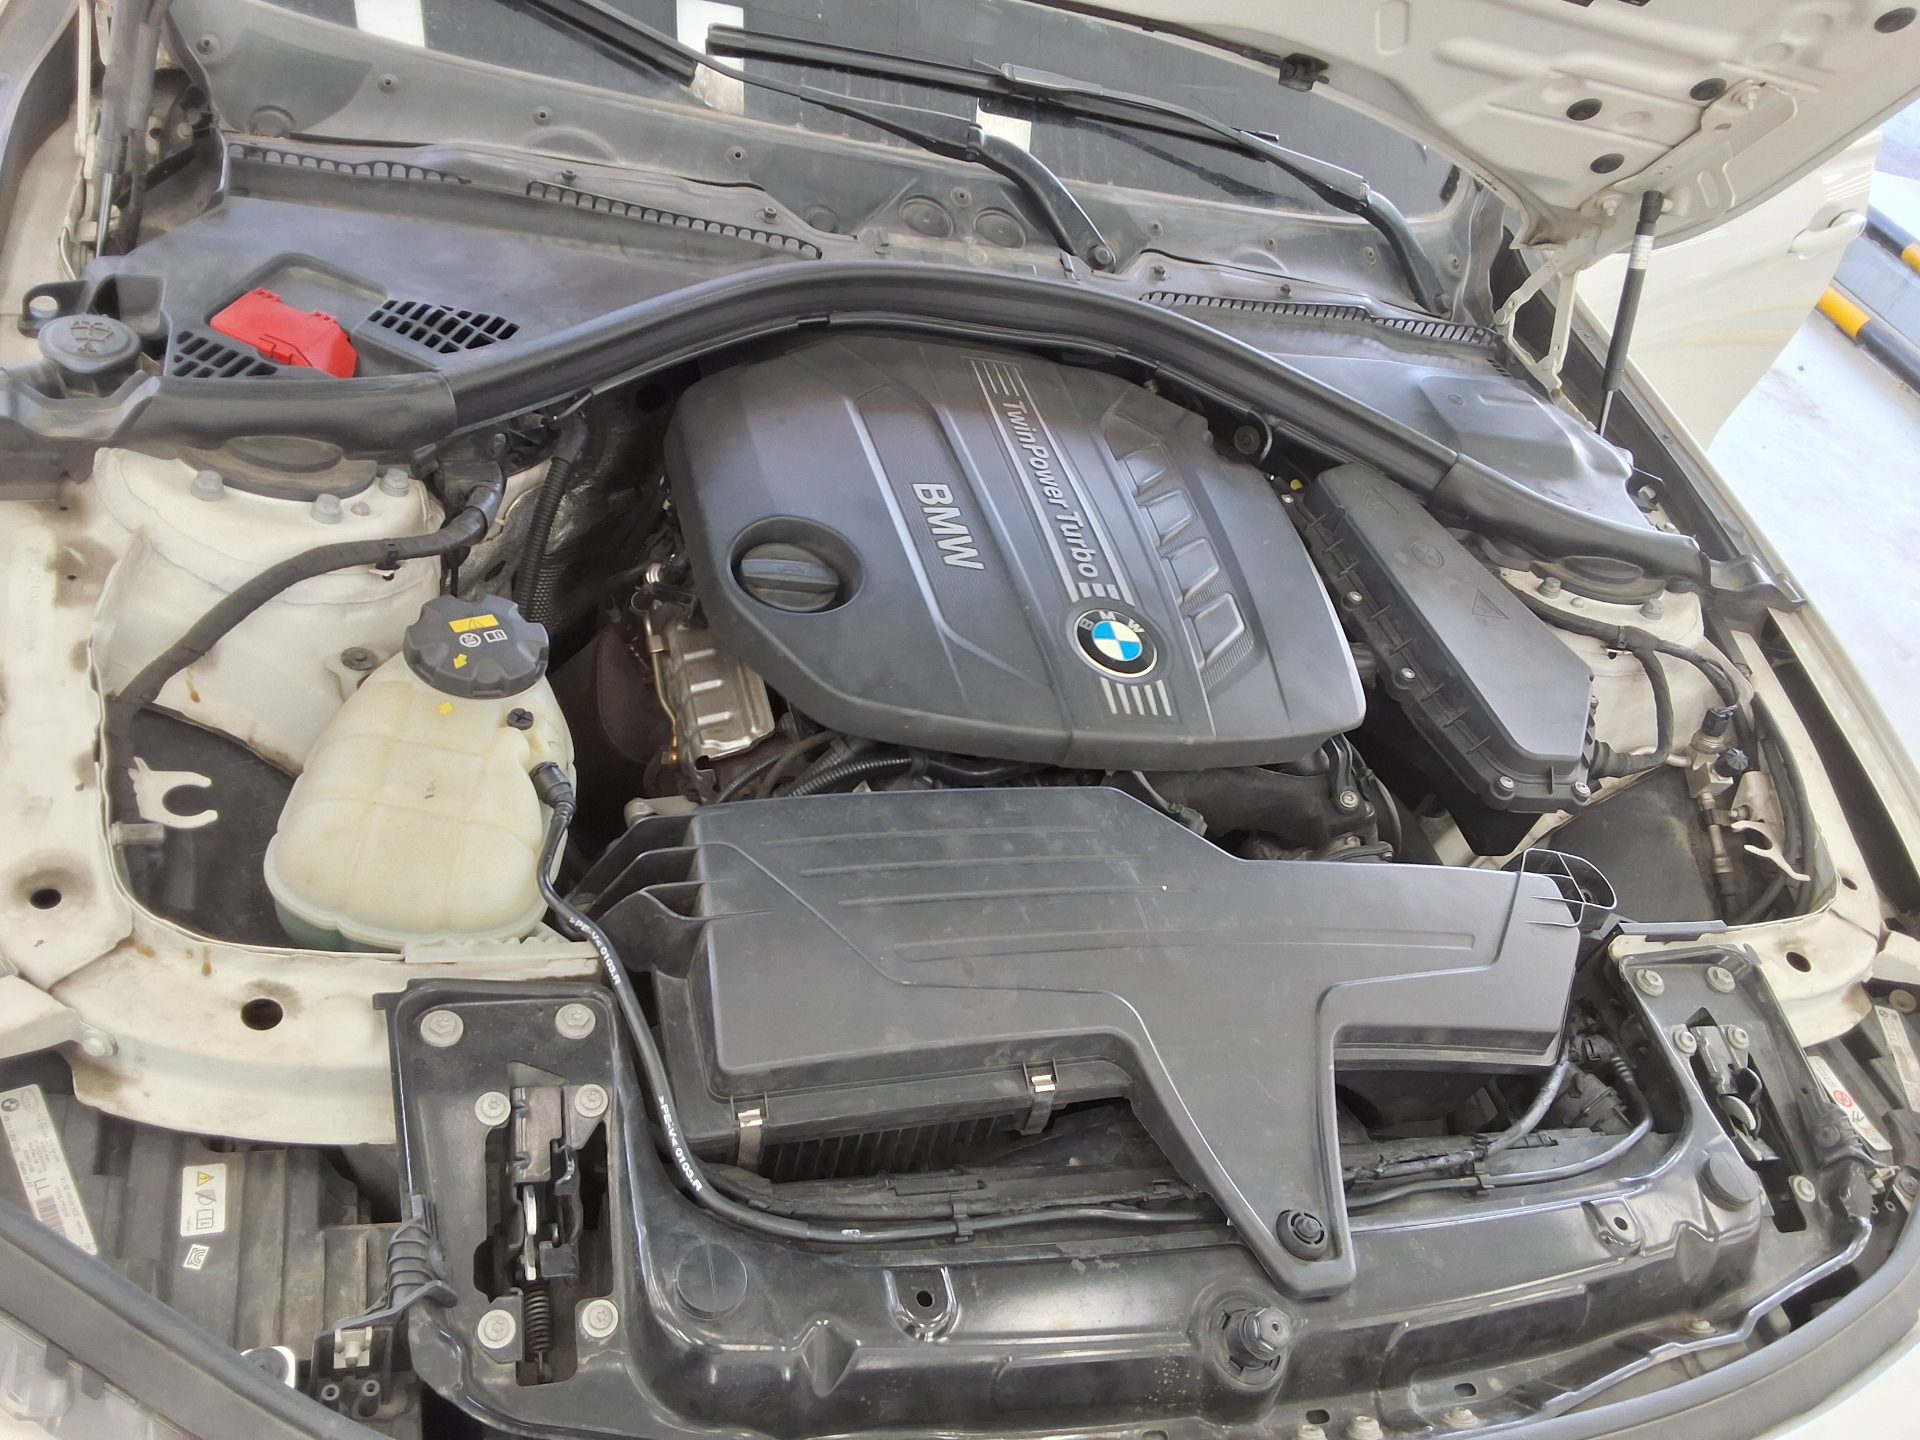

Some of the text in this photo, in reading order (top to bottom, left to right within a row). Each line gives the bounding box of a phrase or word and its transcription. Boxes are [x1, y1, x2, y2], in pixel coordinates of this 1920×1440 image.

[912, 483, 985, 570] BMW
[1002, 401, 1099, 578] TwinPower Turbo
[1079, 609, 1146, 633] BMW
